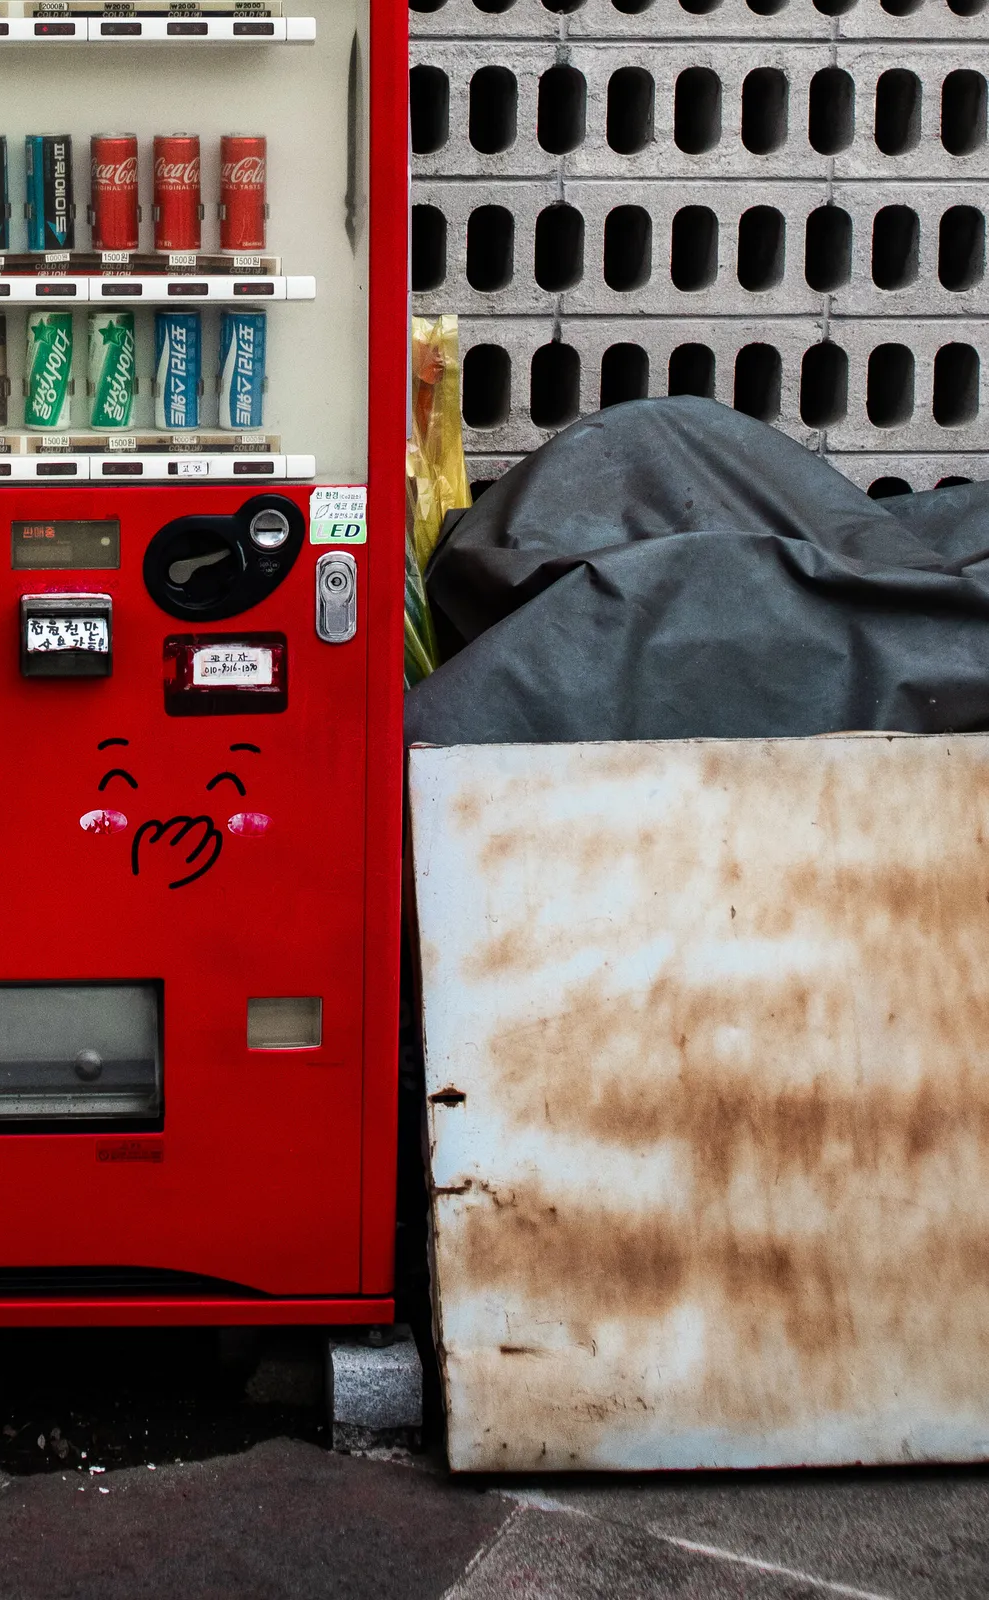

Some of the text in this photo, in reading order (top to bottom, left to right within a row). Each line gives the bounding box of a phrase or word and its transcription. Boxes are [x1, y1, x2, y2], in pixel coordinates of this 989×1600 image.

[53, 143, 67, 233] 파워에이드
[103, 253, 128, 262] 1500원
[170, 256, 196, 266] 1500원
[235, 258, 260, 267] 1500원
[32, 328, 72, 420] 칠성사이다
[103, 329, 136, 420] 칠성사이다
[170, 324, 187, 426] 포카리 스웨트
[236, 323, 254, 426] 포카리 스웨트
[43, 437, 68, 446] 1500원
[110, 439, 135, 448] 1500원
[333, 502, 348, 511] 에코
[22, 526, 55, 539] 판매중
[315, 523, 361, 538] LED
